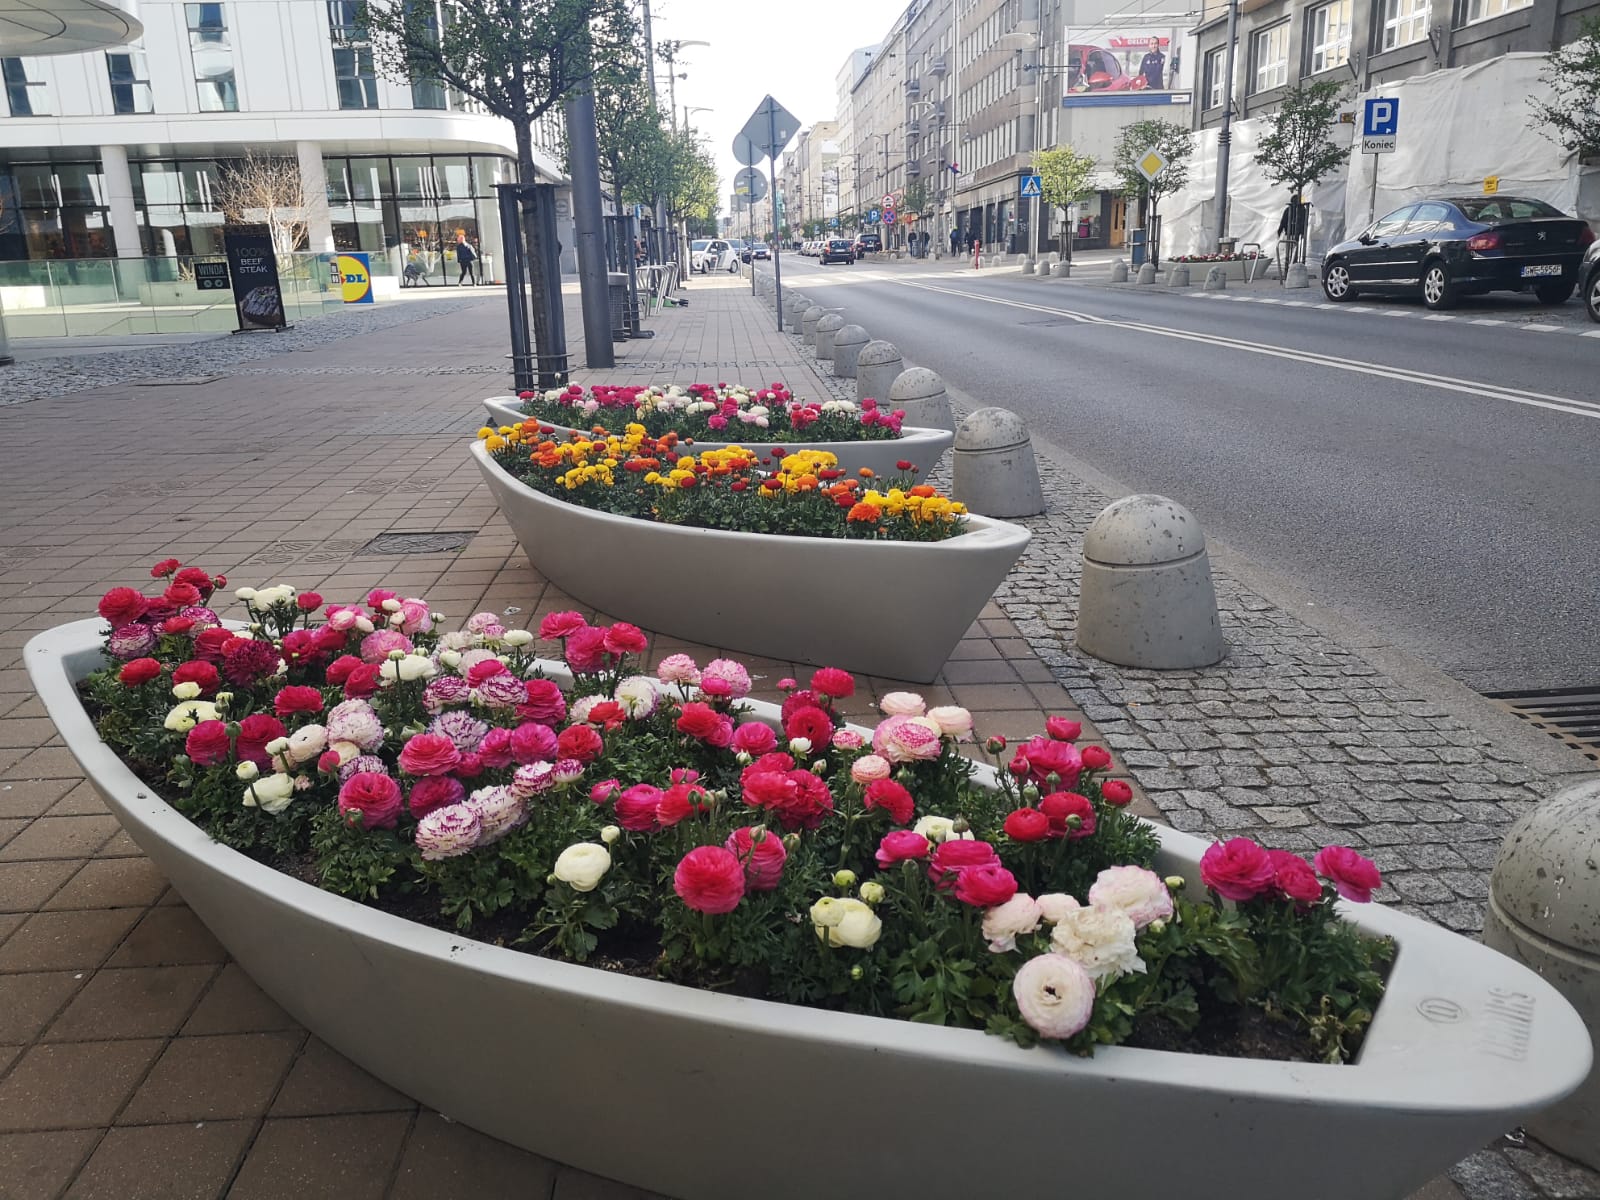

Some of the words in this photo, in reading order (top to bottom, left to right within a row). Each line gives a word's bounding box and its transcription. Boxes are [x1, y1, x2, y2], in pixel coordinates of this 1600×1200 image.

[1371, 102, 1392, 132] P
[1364, 140, 1394, 149] Koniec
[871, 210, 878, 220] P
[240, 257, 264, 265] BEEF
[239, 265, 268, 274] STEAK
